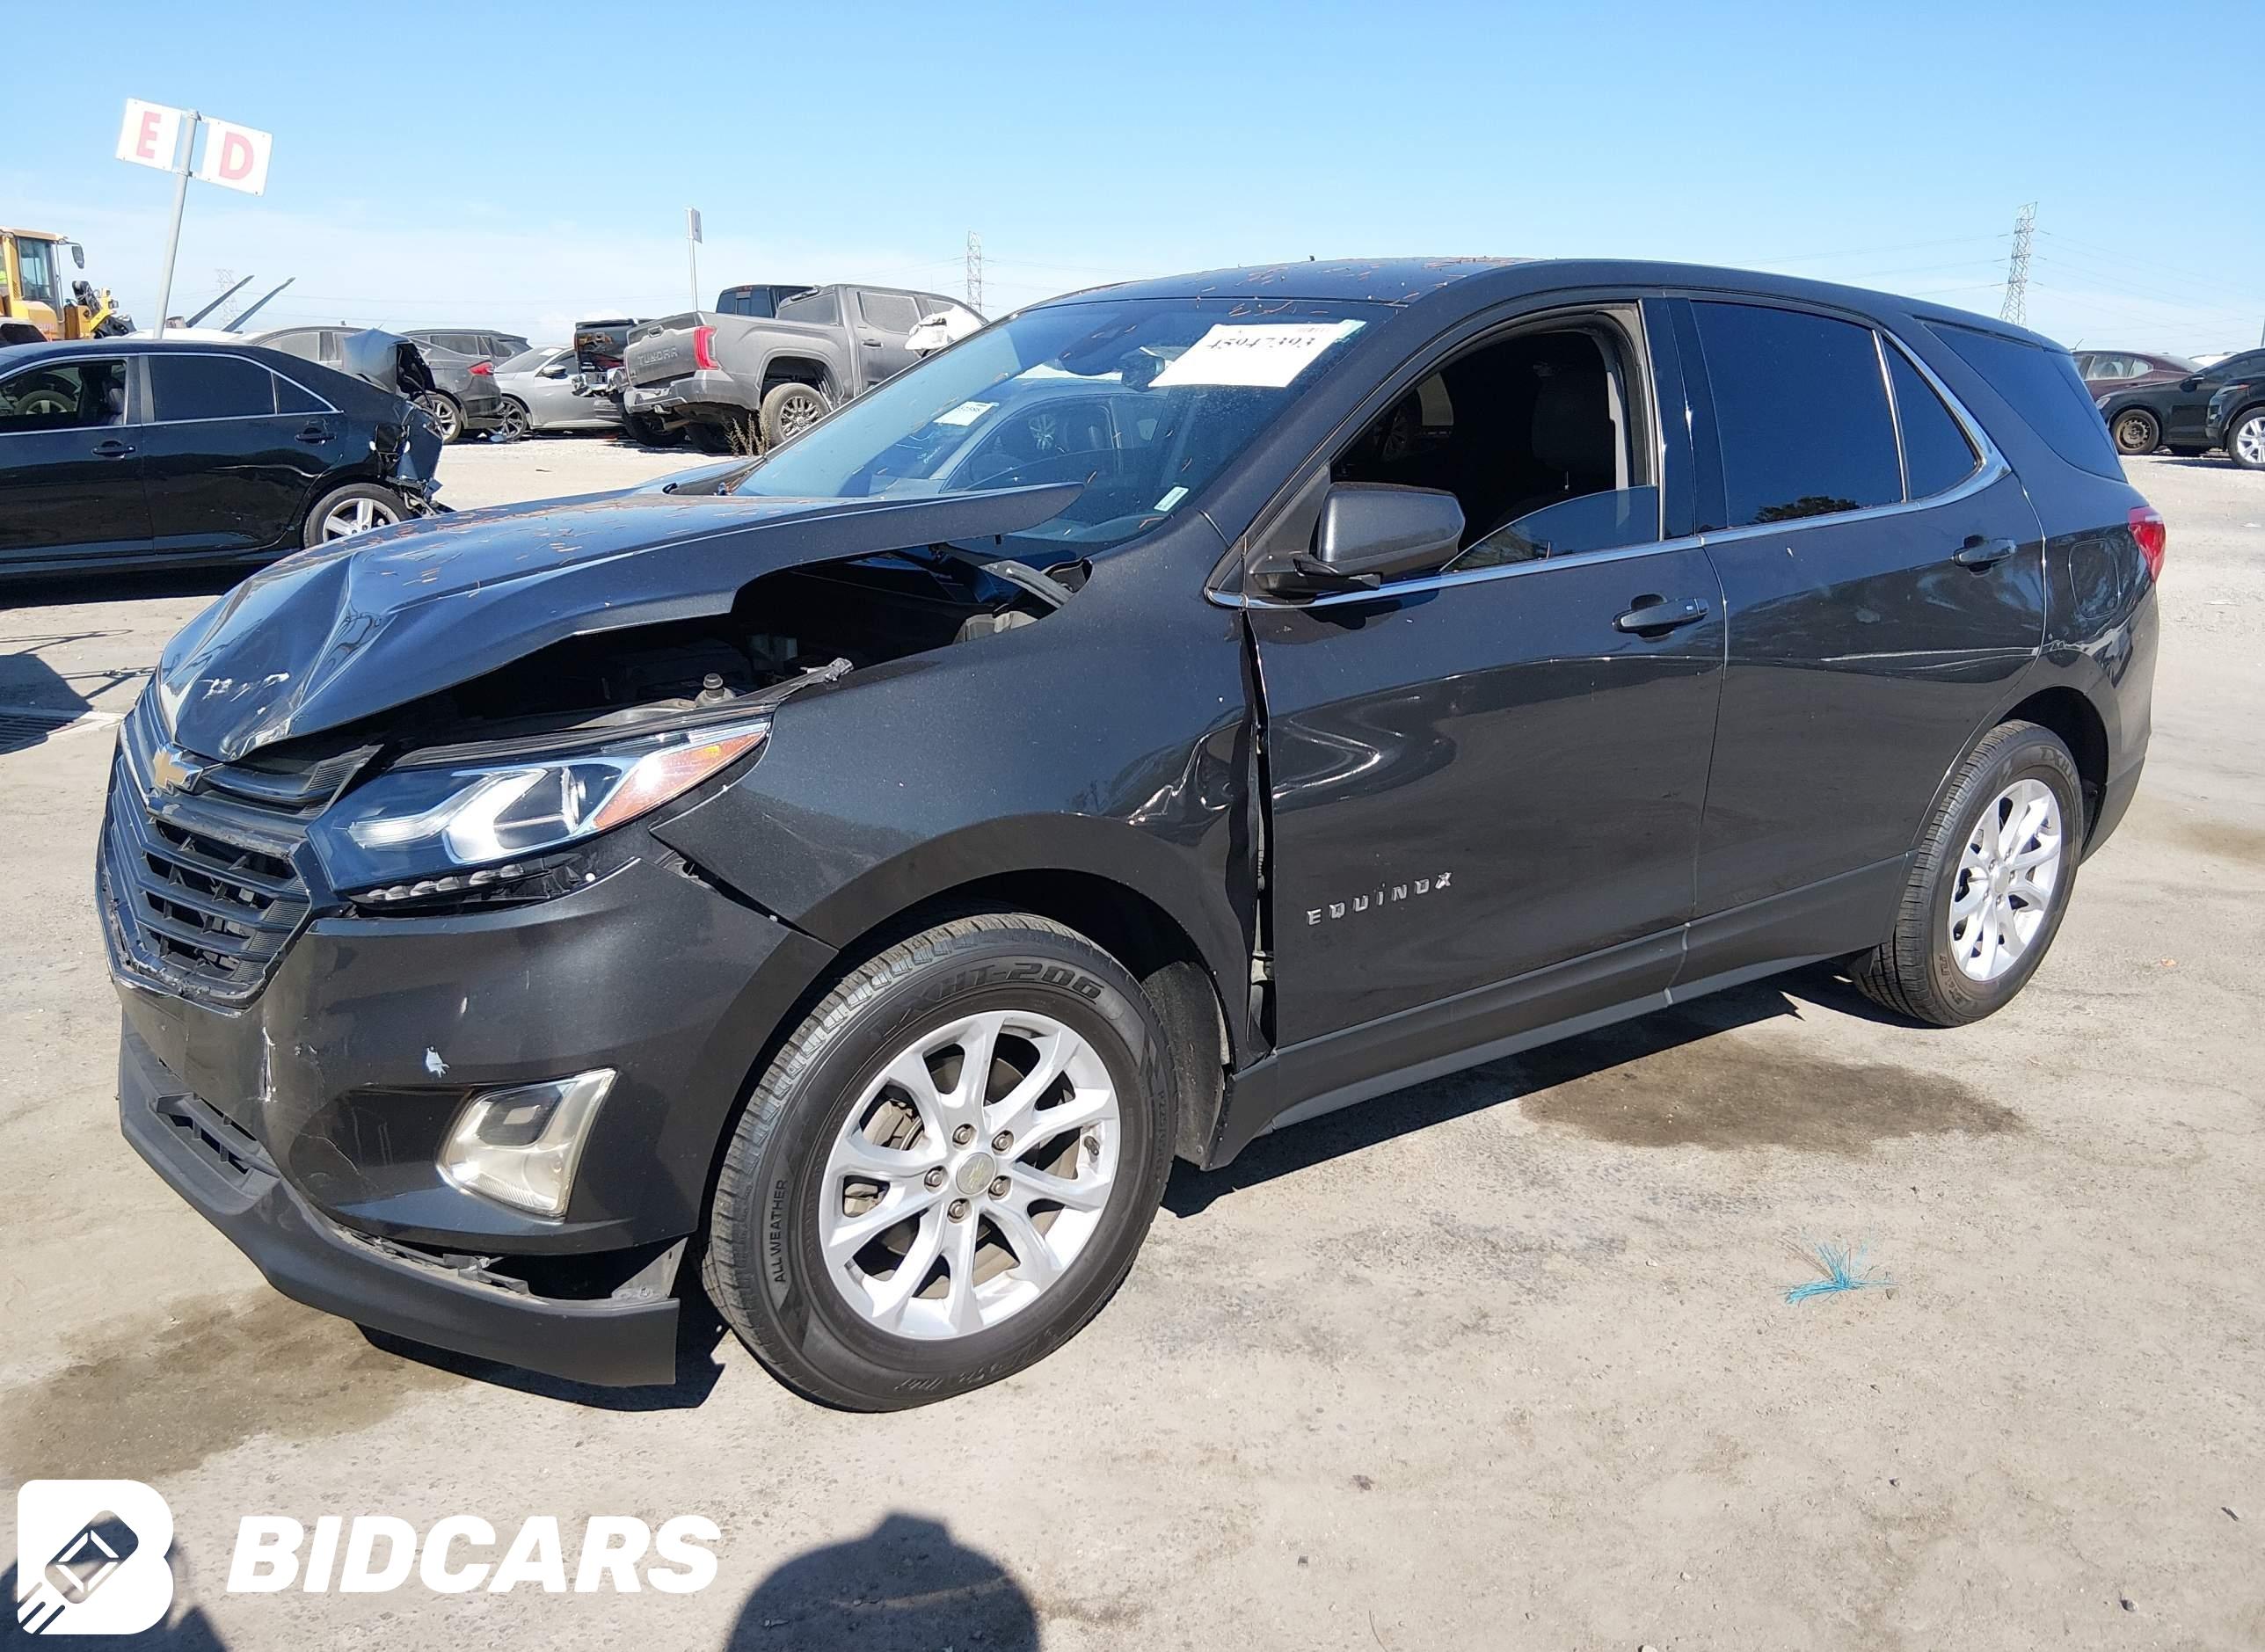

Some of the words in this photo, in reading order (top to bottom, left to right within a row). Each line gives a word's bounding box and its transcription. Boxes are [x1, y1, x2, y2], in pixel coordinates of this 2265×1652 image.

[135, 111, 162, 159] E
[219, 131, 255, 180] D
[637, 346, 679, 366] TUNDRA
